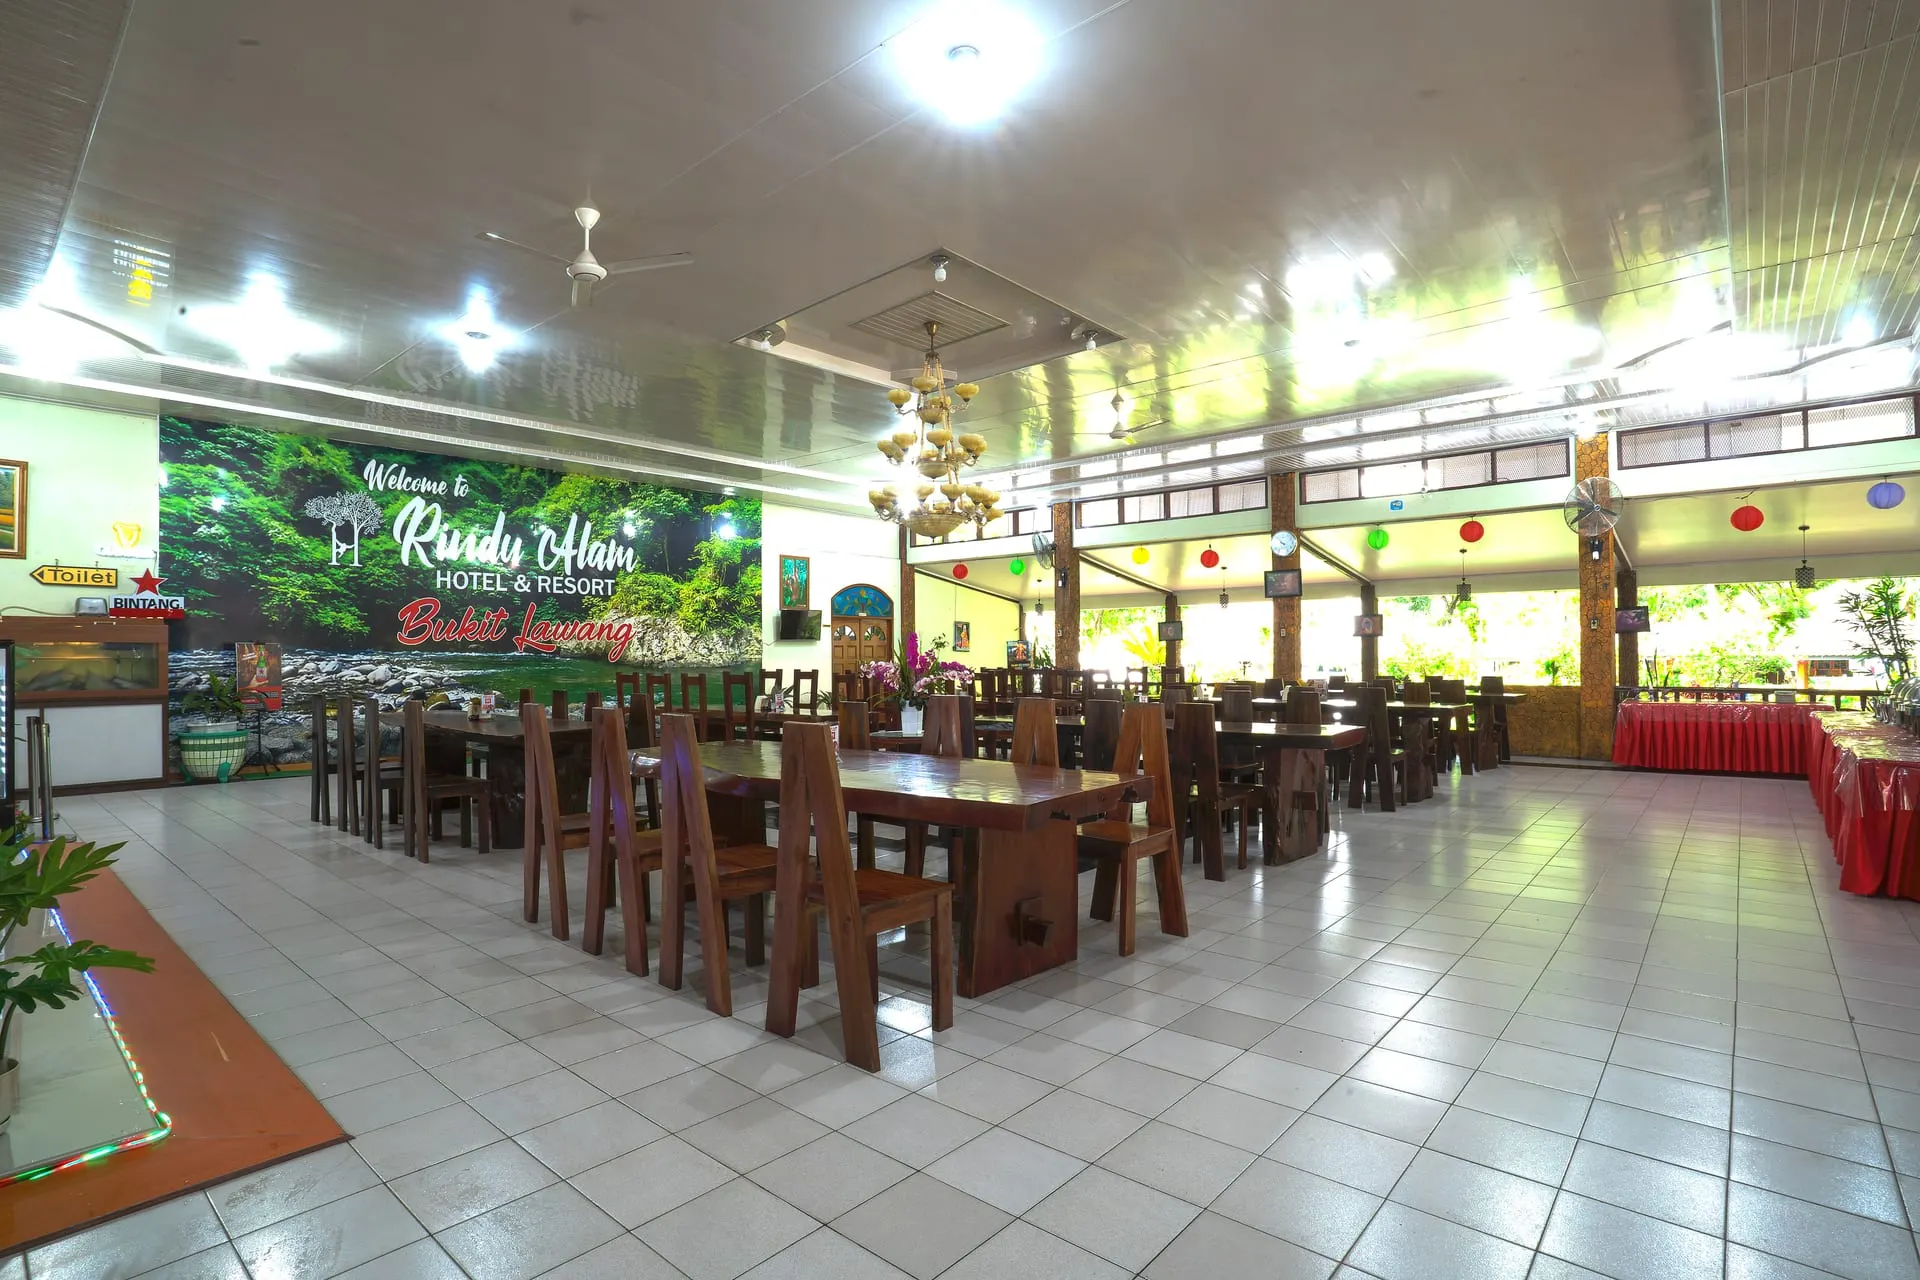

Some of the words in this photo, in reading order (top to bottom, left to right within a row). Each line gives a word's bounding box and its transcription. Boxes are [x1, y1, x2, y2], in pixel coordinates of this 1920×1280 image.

[363, 459, 448, 493] Welcome
[454, 474, 470, 498] to
[392, 496, 524, 568] Rindu
[537, 513, 637, 575] Alam
[48, 568, 113, 584] Toilet
[436, 570, 508, 592] HOTEL
[514, 573, 531, 594] &
[537, 576, 615, 597] RESORT
[396, 597, 508, 646] Bukit
[514, 601, 637, 663] Lawang
